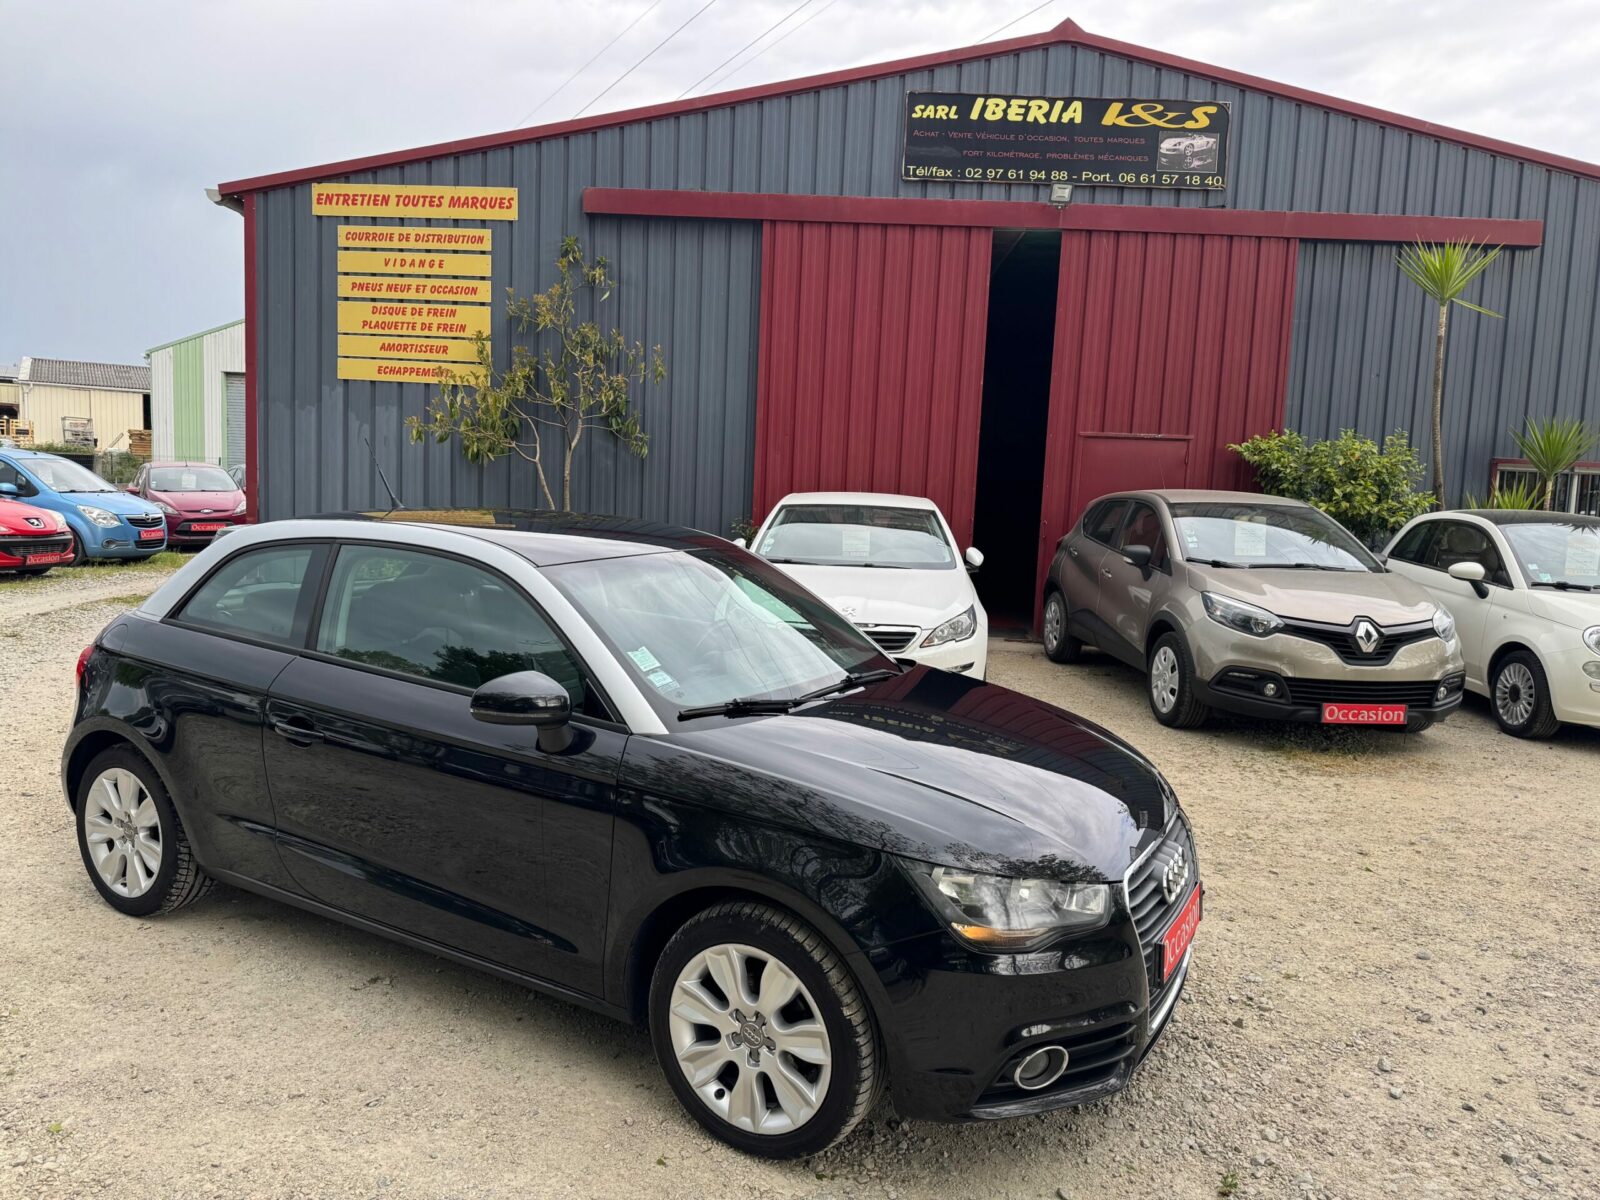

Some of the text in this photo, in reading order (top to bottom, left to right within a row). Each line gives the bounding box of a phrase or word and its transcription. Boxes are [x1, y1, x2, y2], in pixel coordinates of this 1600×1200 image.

[912, 97, 1218, 129] SARL IBERIA I&S
[913, 129, 939, 137] ACHAT
[948, 131, 973, 139] VENTE
[1107, 137, 1145, 145] MARQUES
[907, 165, 953, 178] Tél/fax
[965, 167, 982, 178] 02
[986, 168, 1004, 179] 97
[1008, 169, 1024, 179] 61
[1029, 170, 1046, 180] 94
[1050, 170, 1068, 181] 88
[1082, 171, 1114, 183] Port.
[1118, 172, 1136, 183] 06
[1140, 173, 1156, 184] 61
[1161, 174, 1179, 184] 57
[1184, 175, 1200, 185] 18
[1204, 175, 1223, 186] 40
[316, 192, 514, 210] ENTRETIEN TOUTES MARQUES
[345, 231, 485, 245] COURROIE DE DISTRIBUTION
[384, 257, 445, 269] VIDANGE
[351, 281, 478, 296] PNEUS NEUF ET OCCASION
[371, 305, 457, 318] DISQUE DE FREIN
[362, 320, 467, 333] PLAQUETTE DE FREIN
[379, 342, 449, 355] AMORTISSEUR
[28, 554, 60, 564] Occasion
[1324, 705, 1405, 722] Occasion
